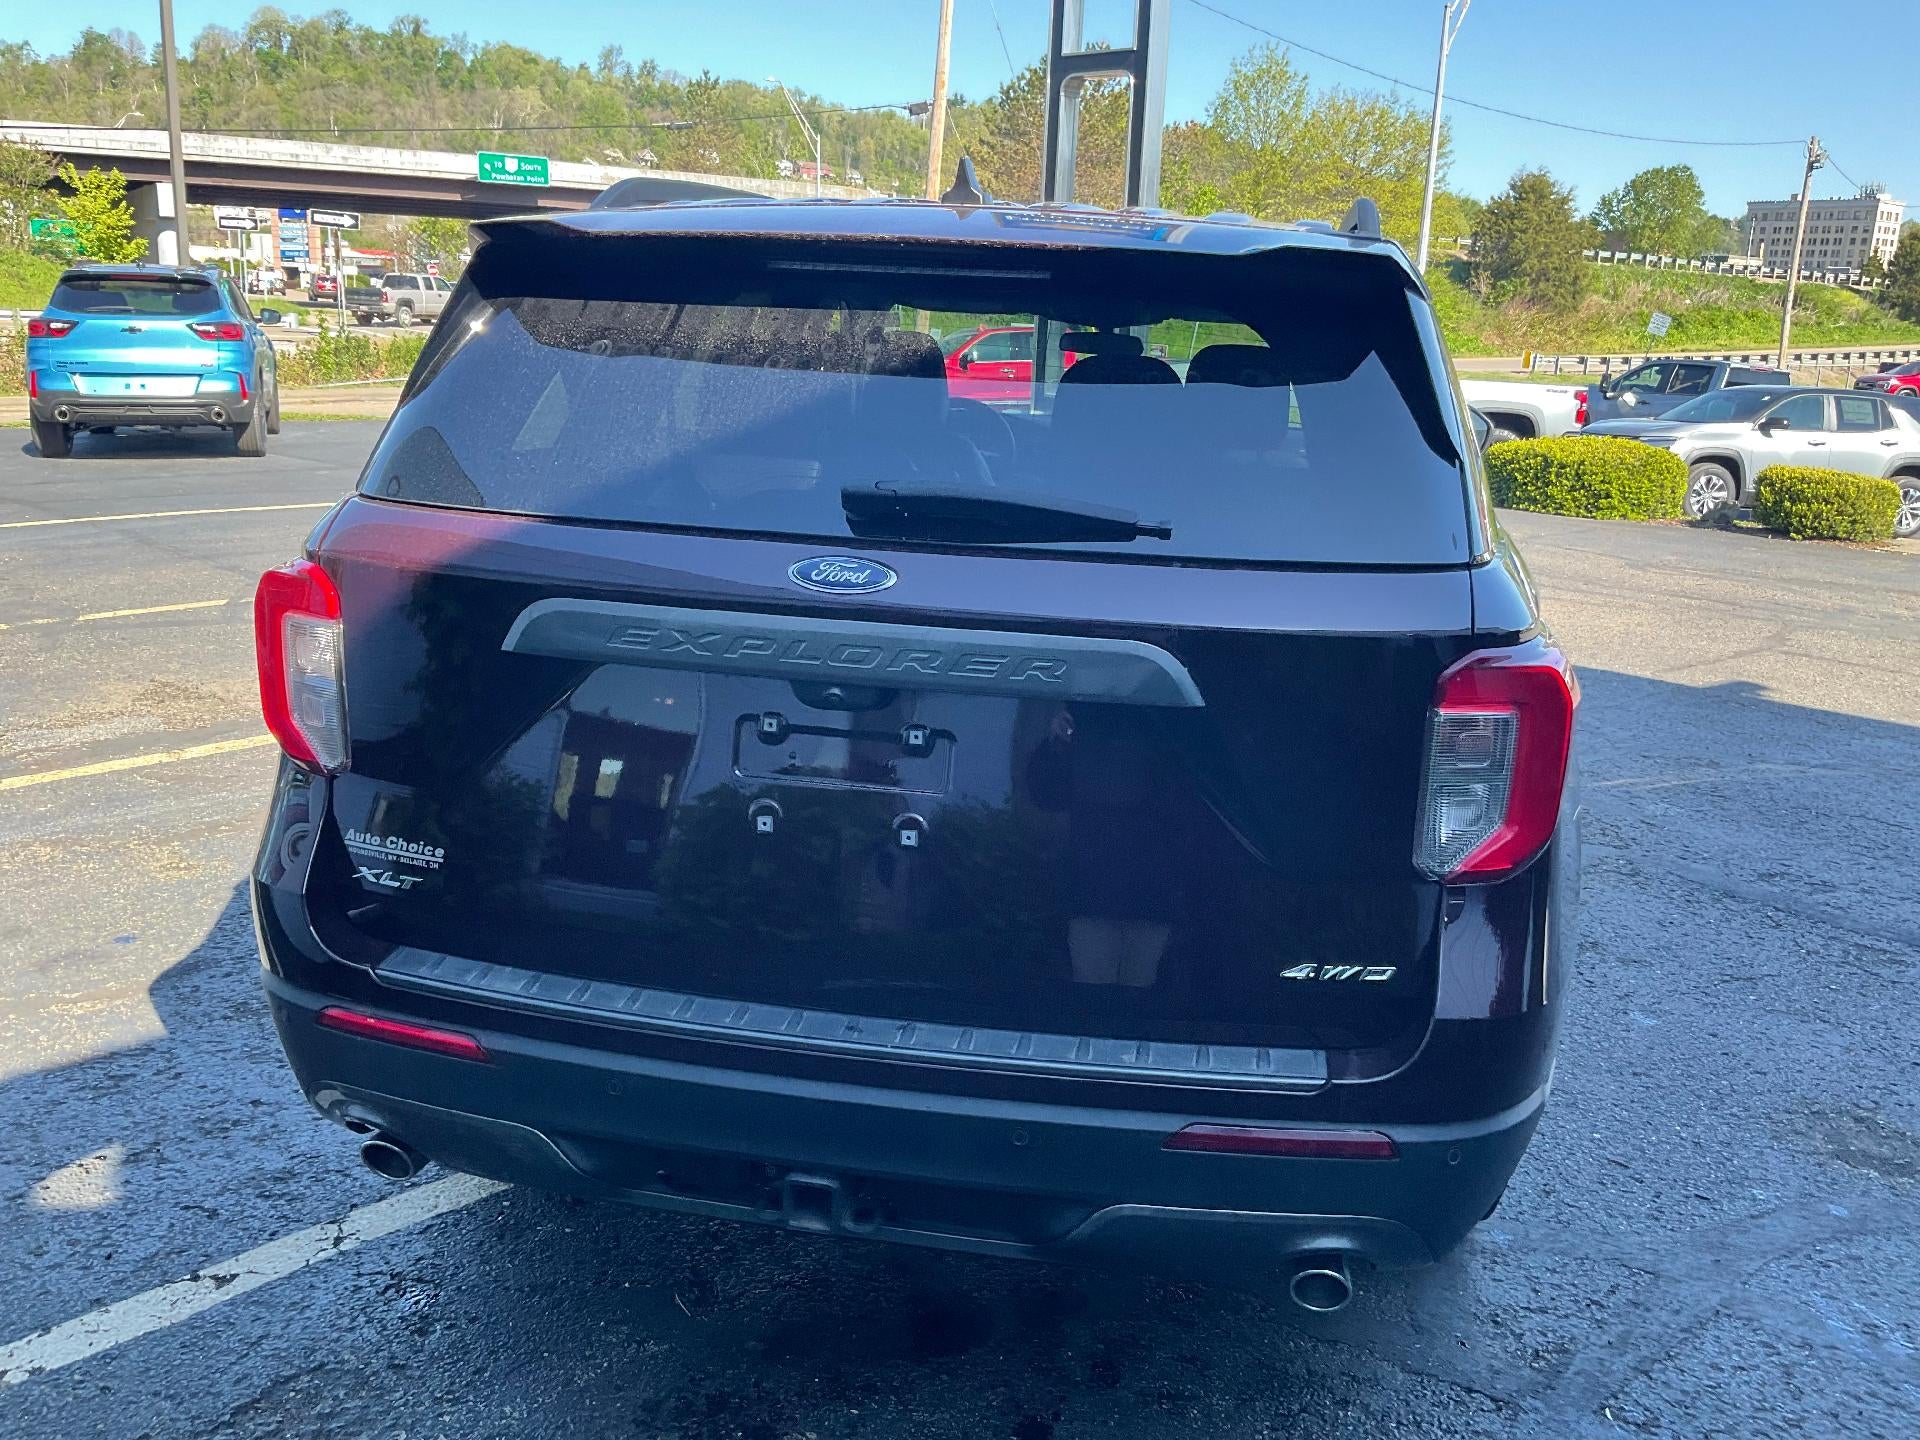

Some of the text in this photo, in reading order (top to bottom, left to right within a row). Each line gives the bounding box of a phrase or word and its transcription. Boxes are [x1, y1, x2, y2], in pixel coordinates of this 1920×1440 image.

[526, 175, 545, 183] Point
[811, 561, 871, 584] Ford
[603, 624, 1068, 682] EXPLORER
[344, 828, 445, 858] Auto Choice
[352, 866, 424, 890] XLT
[1279, 963, 1397, 981] 4WD
